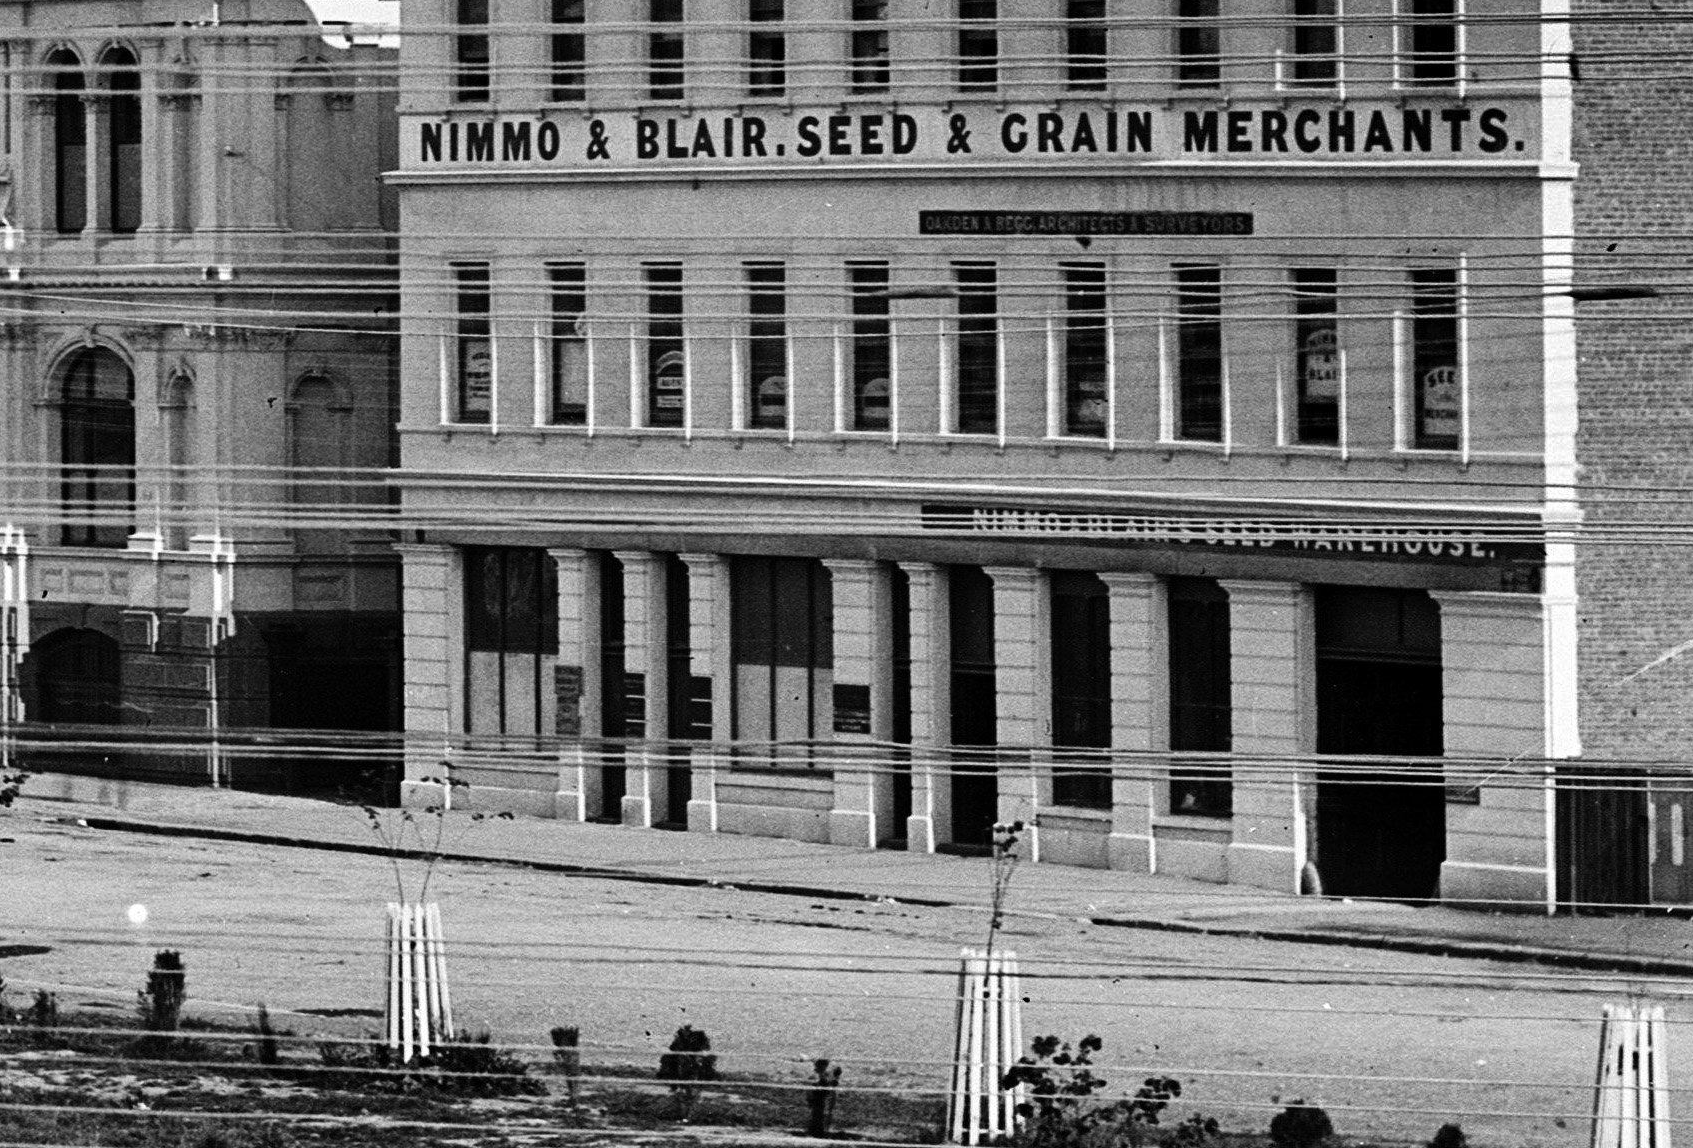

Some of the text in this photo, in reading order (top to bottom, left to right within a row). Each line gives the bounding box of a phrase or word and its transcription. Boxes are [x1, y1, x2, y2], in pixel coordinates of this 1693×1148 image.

[421, 120, 560, 163] NIMMO
[585, 118, 611, 161] &
[797, 114, 919, 156] SEED
[946, 112, 973, 154] &
[1000, 110, 1152, 153] GRAIN
[1183, 107, 1524, 153] MERCHANTS.
[925, 215, 980, 231] OAKDEN
[1038, 215, 1125, 232] ARCHITECTS
[1144, 216, 1245, 232] SURVEYORS
[1427, 370, 1456, 388] SEE
